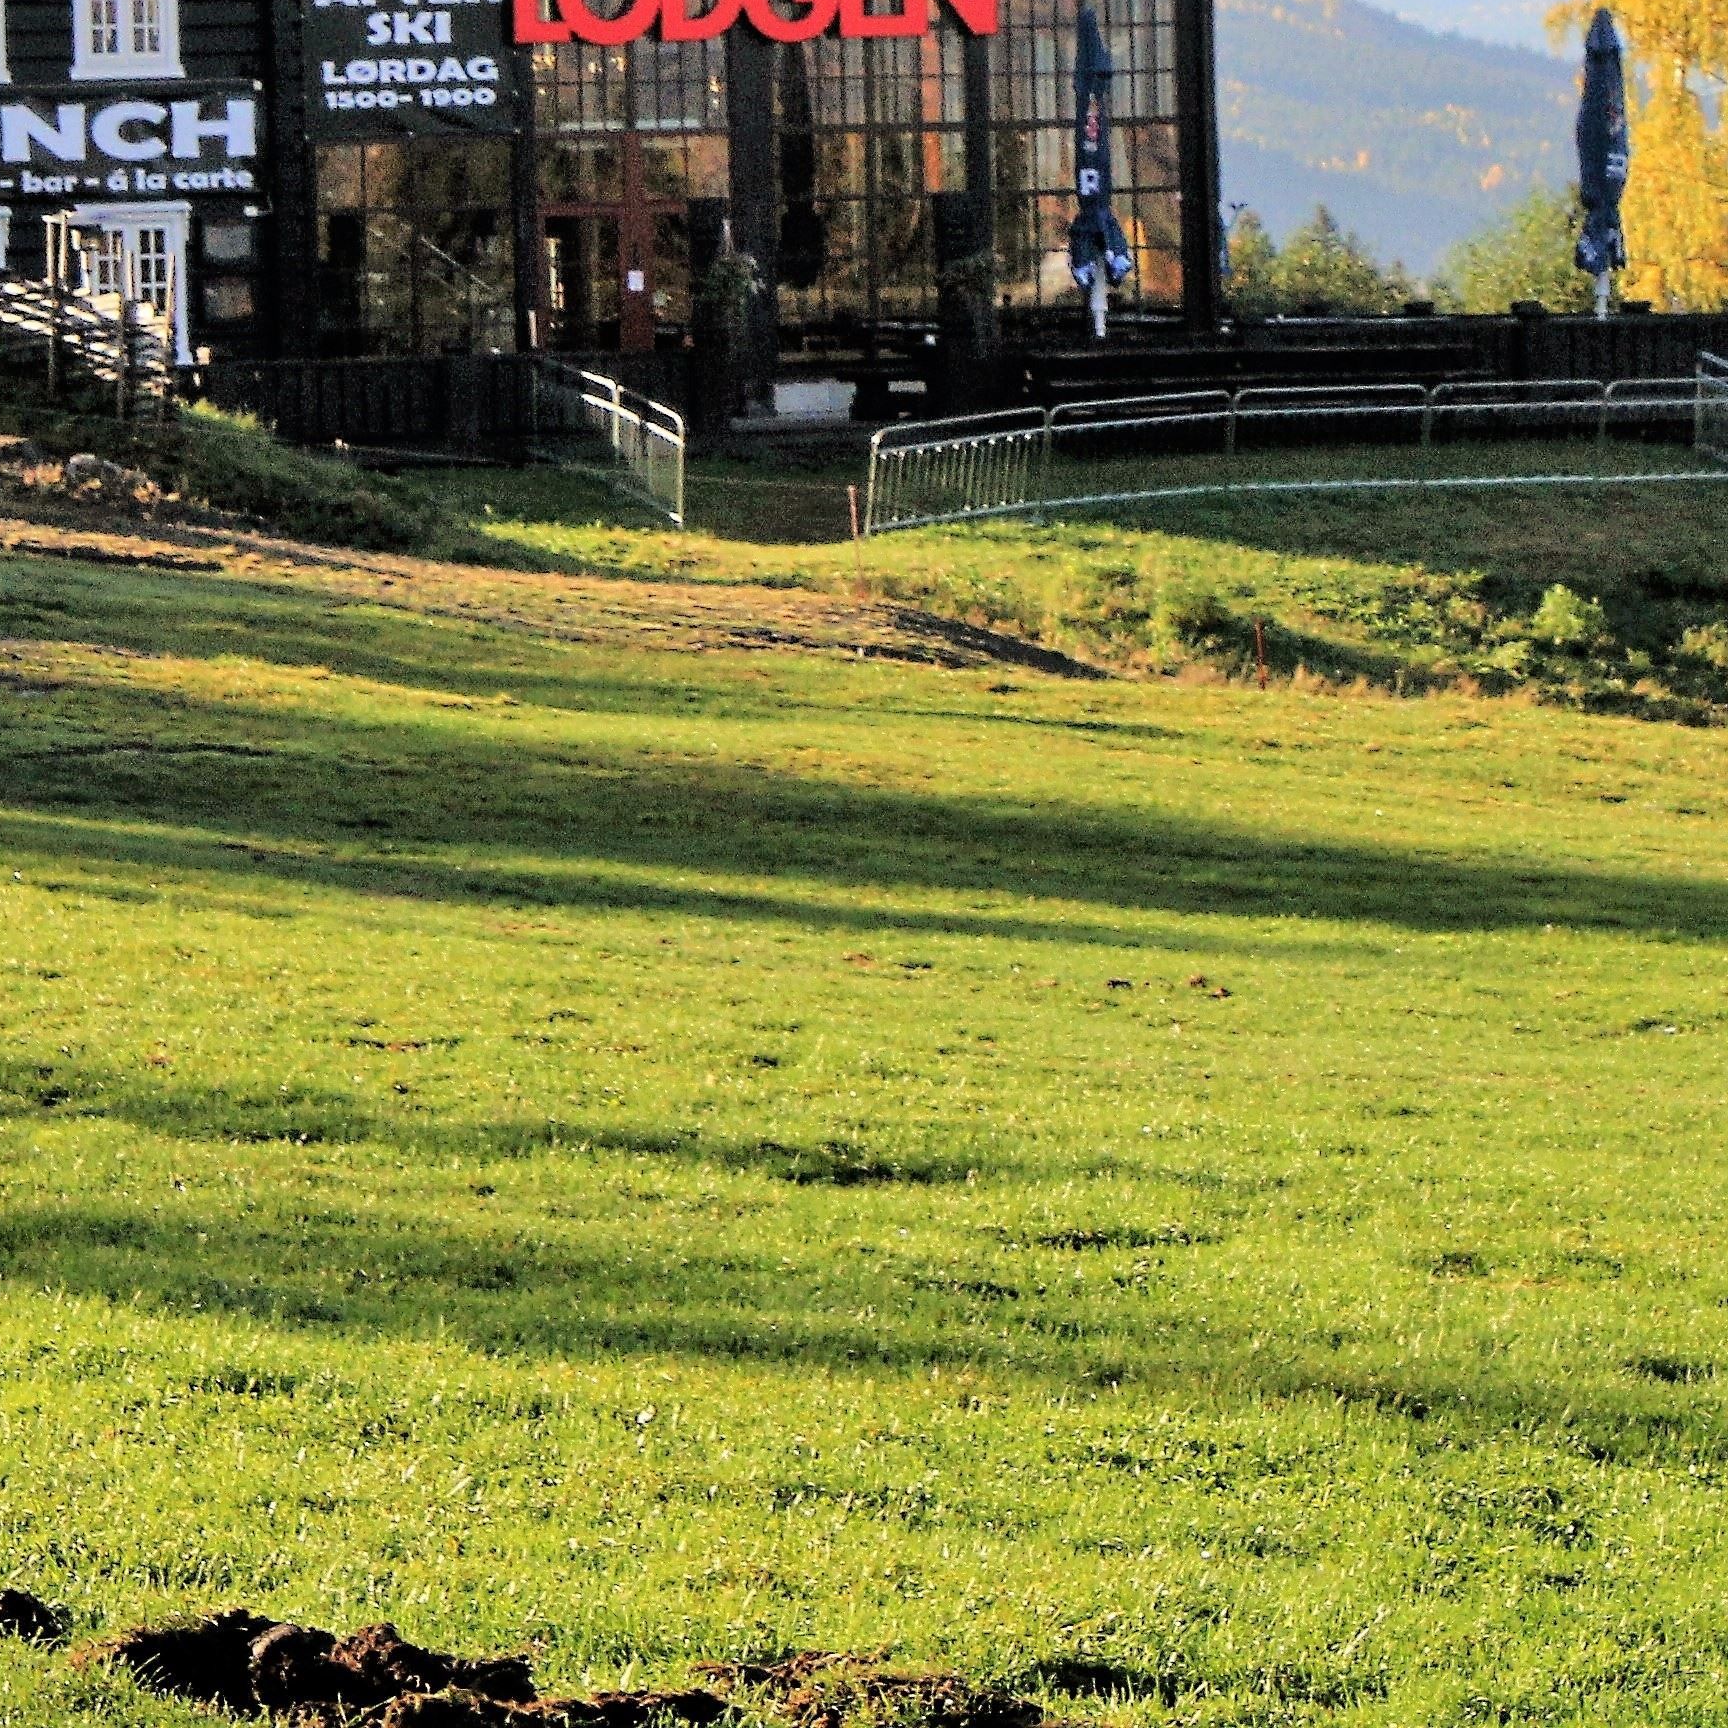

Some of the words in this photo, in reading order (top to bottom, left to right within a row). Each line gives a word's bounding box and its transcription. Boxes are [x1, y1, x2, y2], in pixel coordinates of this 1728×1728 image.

[366, 10, 453, 46] SKI
[321, 56, 500, 85] LØRDAG
[22, 169, 79, 194] bar
[135, 167, 168, 192] la
[173, 167, 255, 192] carte
